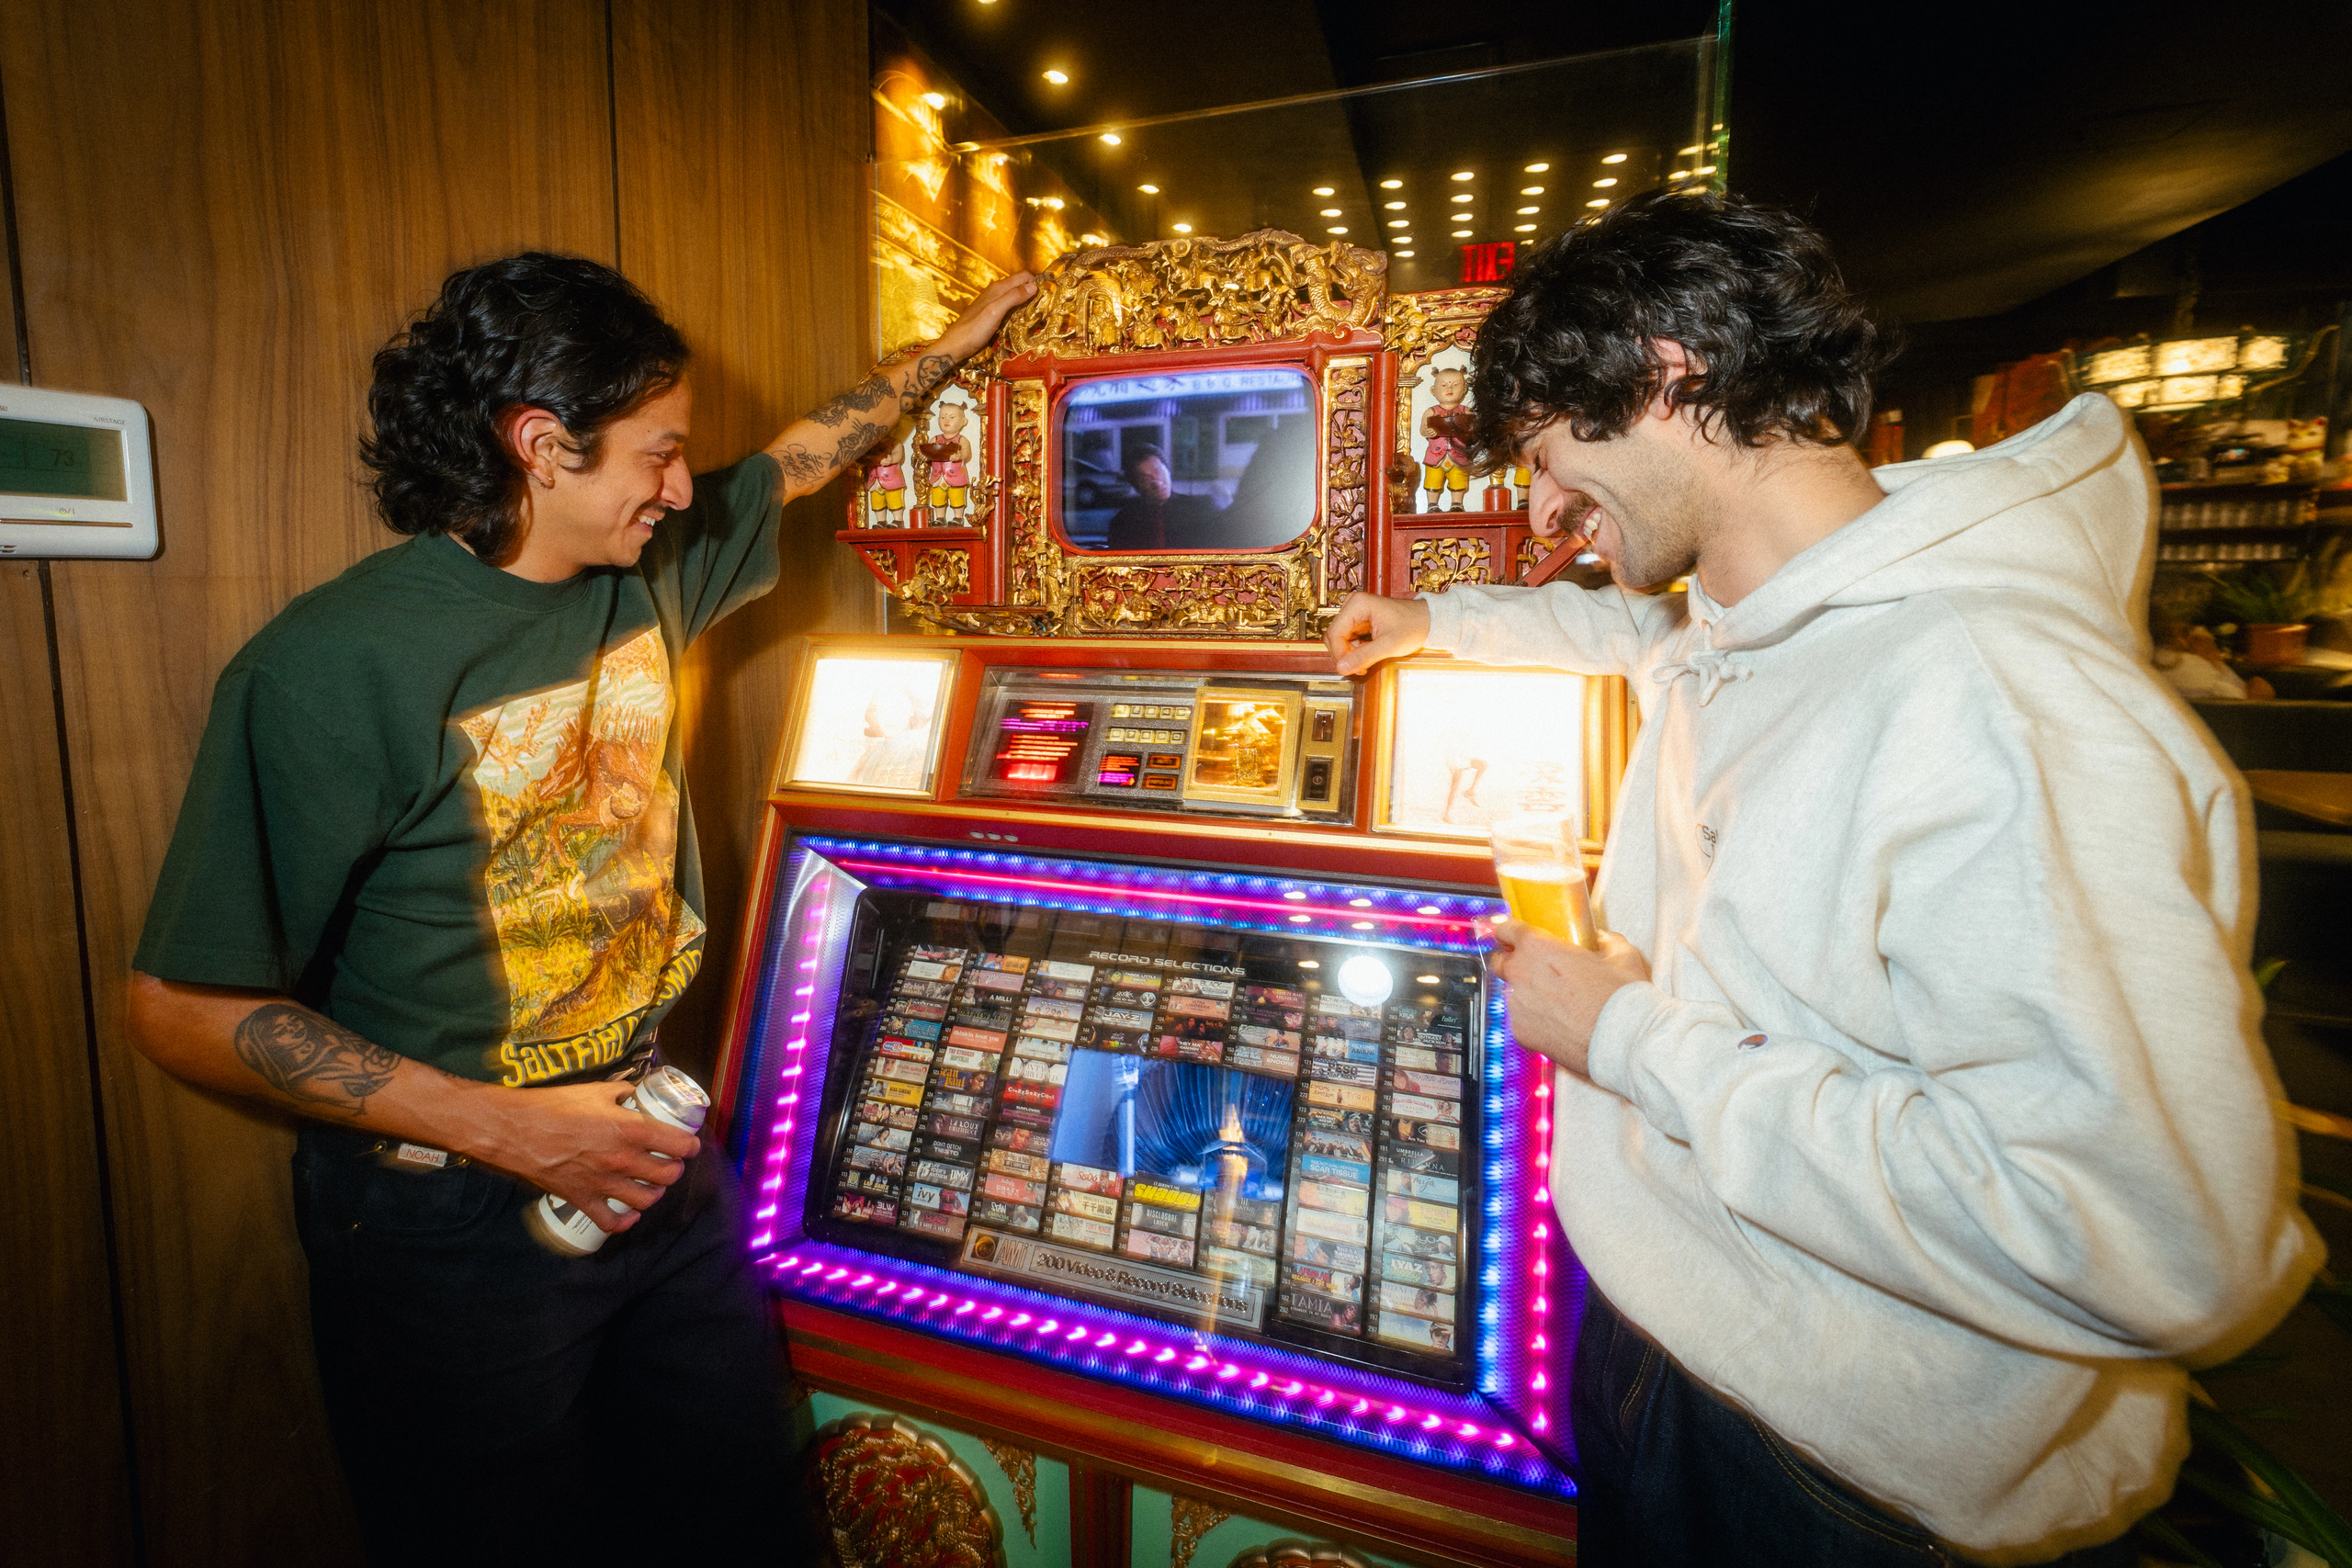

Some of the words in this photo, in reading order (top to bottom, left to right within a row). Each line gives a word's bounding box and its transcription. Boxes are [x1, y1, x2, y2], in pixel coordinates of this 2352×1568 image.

[94, 417, 126, 425] AIRSTAGE
[50, 448, 74, 467] 73
[1089, 951, 1150, 964] RECORD
[1154, 958, 1246, 976] SELECTIONS
[1103, 1010, 1139, 1021] JAY-Z
[1357, 1020, 1370, 1028] JIN
[954, 1030, 974, 1038] thinkin
[1266, 1058, 1295, 1066] ENCORE
[1328, 1062, 1359, 1076] PESO
[1392, 1098, 1433, 1110] Heartbreaker
[950, 1119, 958, 1127] LA
[960, 1122, 979, 1130] ROUX
[406, 1148, 440, 1163] NOAH
[1396, 1148, 1423, 1156] UMBRELLA
[950, 1169, 969, 1183] DMX
[1310, 1164, 1329, 1173] SCAR
[1332, 1168, 1358, 1179] TISSUE
[918, 1187, 935, 1202] ivy
[996, 1185, 1020, 1193] CRAZY
[876, 1201, 895, 1211] 3LW
[987, 1211, 1009, 1220] EMINEM
[1147, 1210, 1177, 1222] DISCLOSURE
[1390, 1258, 1423, 1273] IYAZ
[1037, 1253, 1065, 1270] 200
[1067, 1259, 1102, 1279] Video
[1105, 1268, 1116, 1282] &
[1116, 1271, 1170, 1293] Record
[1291, 1293, 1333, 1314] TAMIA
